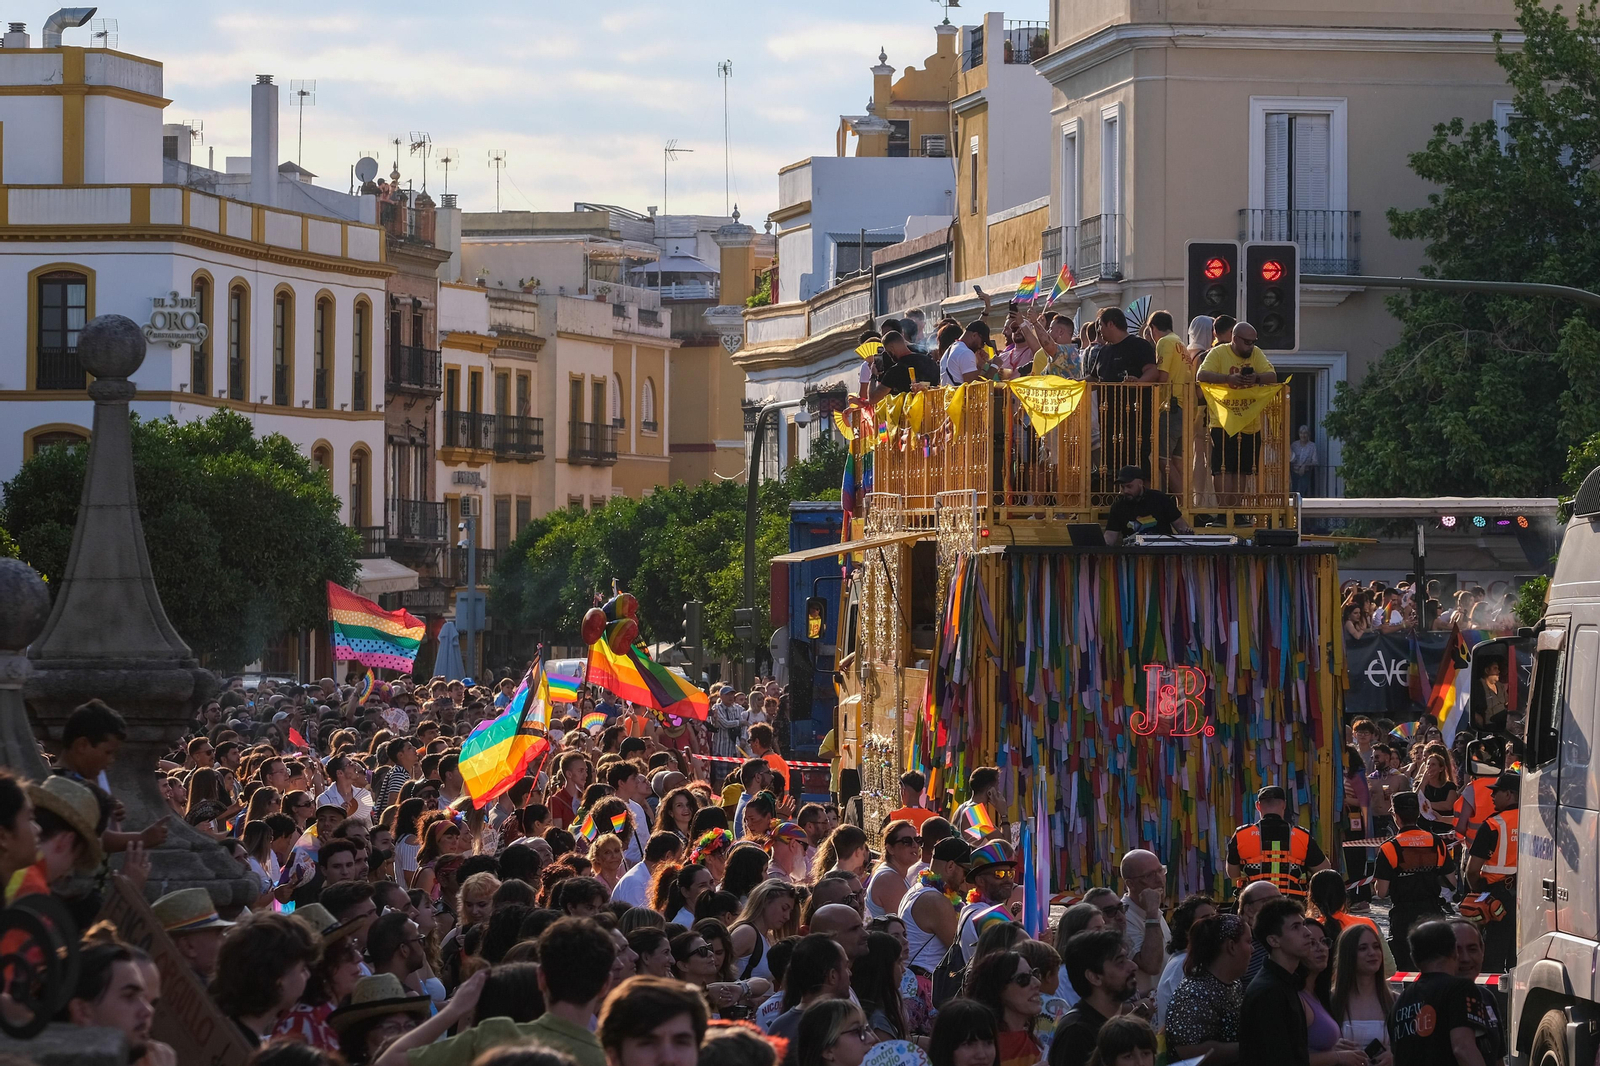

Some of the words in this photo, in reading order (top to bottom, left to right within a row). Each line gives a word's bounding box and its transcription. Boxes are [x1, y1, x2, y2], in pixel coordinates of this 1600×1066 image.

[153, 297, 168, 308] EL
[169, 290, 180, 308] 3
[181, 297, 197, 309] DE
[150, 310, 200, 331] ORO
[1130, 664, 1207, 737] J&B
[1395, 1001, 1425, 1023] CREW
